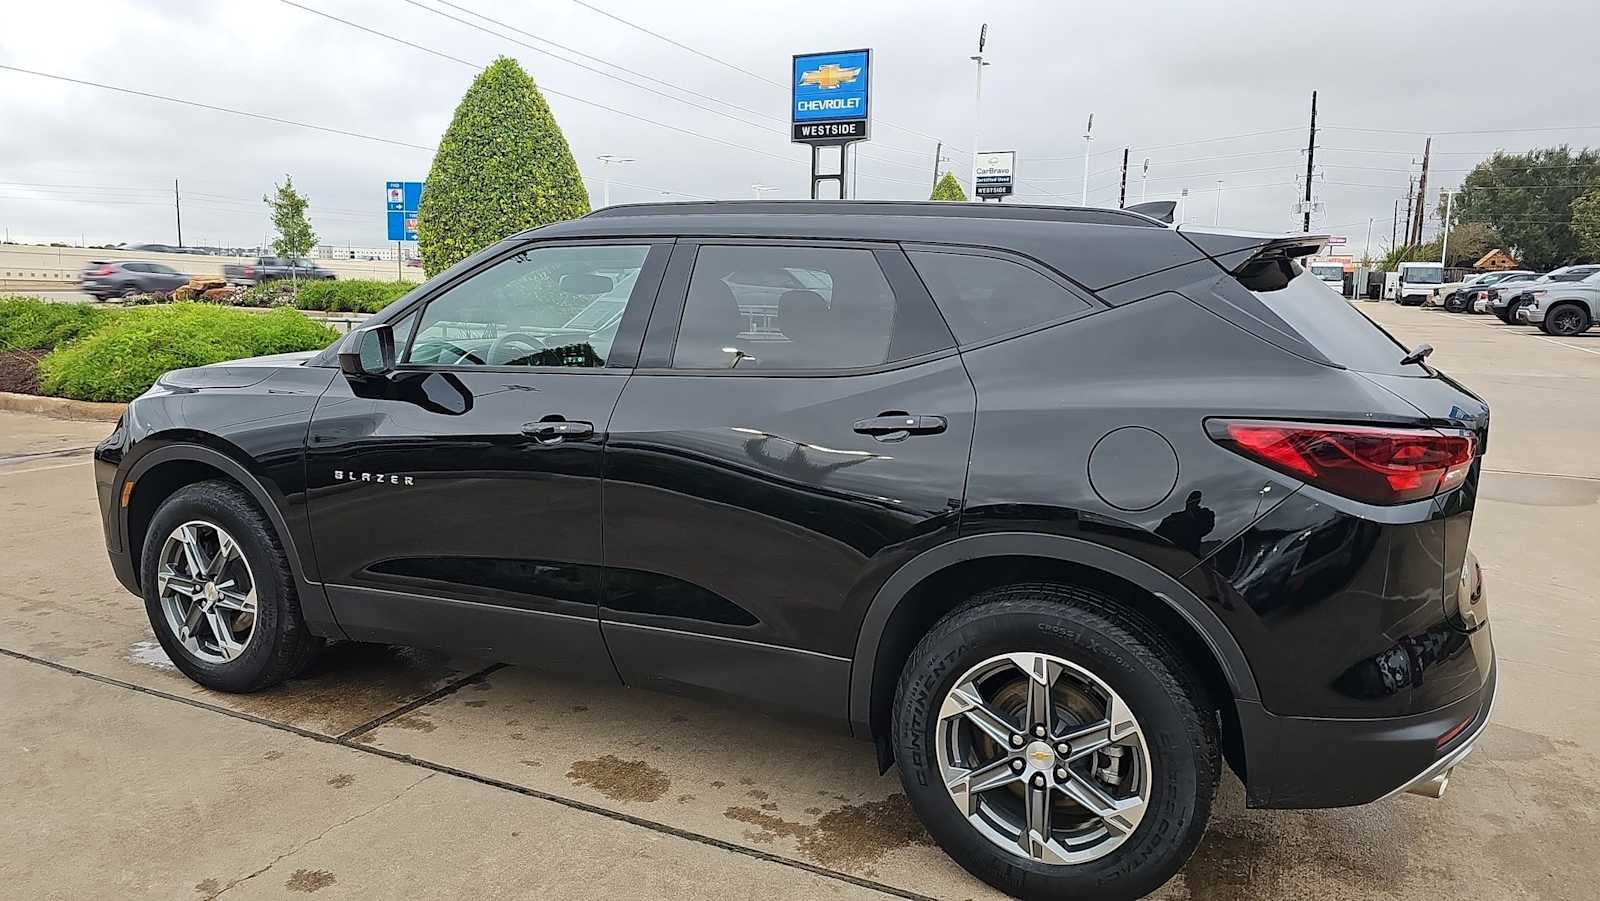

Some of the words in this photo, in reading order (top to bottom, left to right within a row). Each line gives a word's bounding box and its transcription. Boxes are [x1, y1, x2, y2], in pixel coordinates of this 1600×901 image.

[797, 97, 861, 112] CHEVROLET
[801, 124, 856, 136] WESTSIDE
[976, 167, 1010, 175] CarBravo
[334, 470, 414, 486] BLAZER
[911, 640, 977, 787] CONTINENTA
